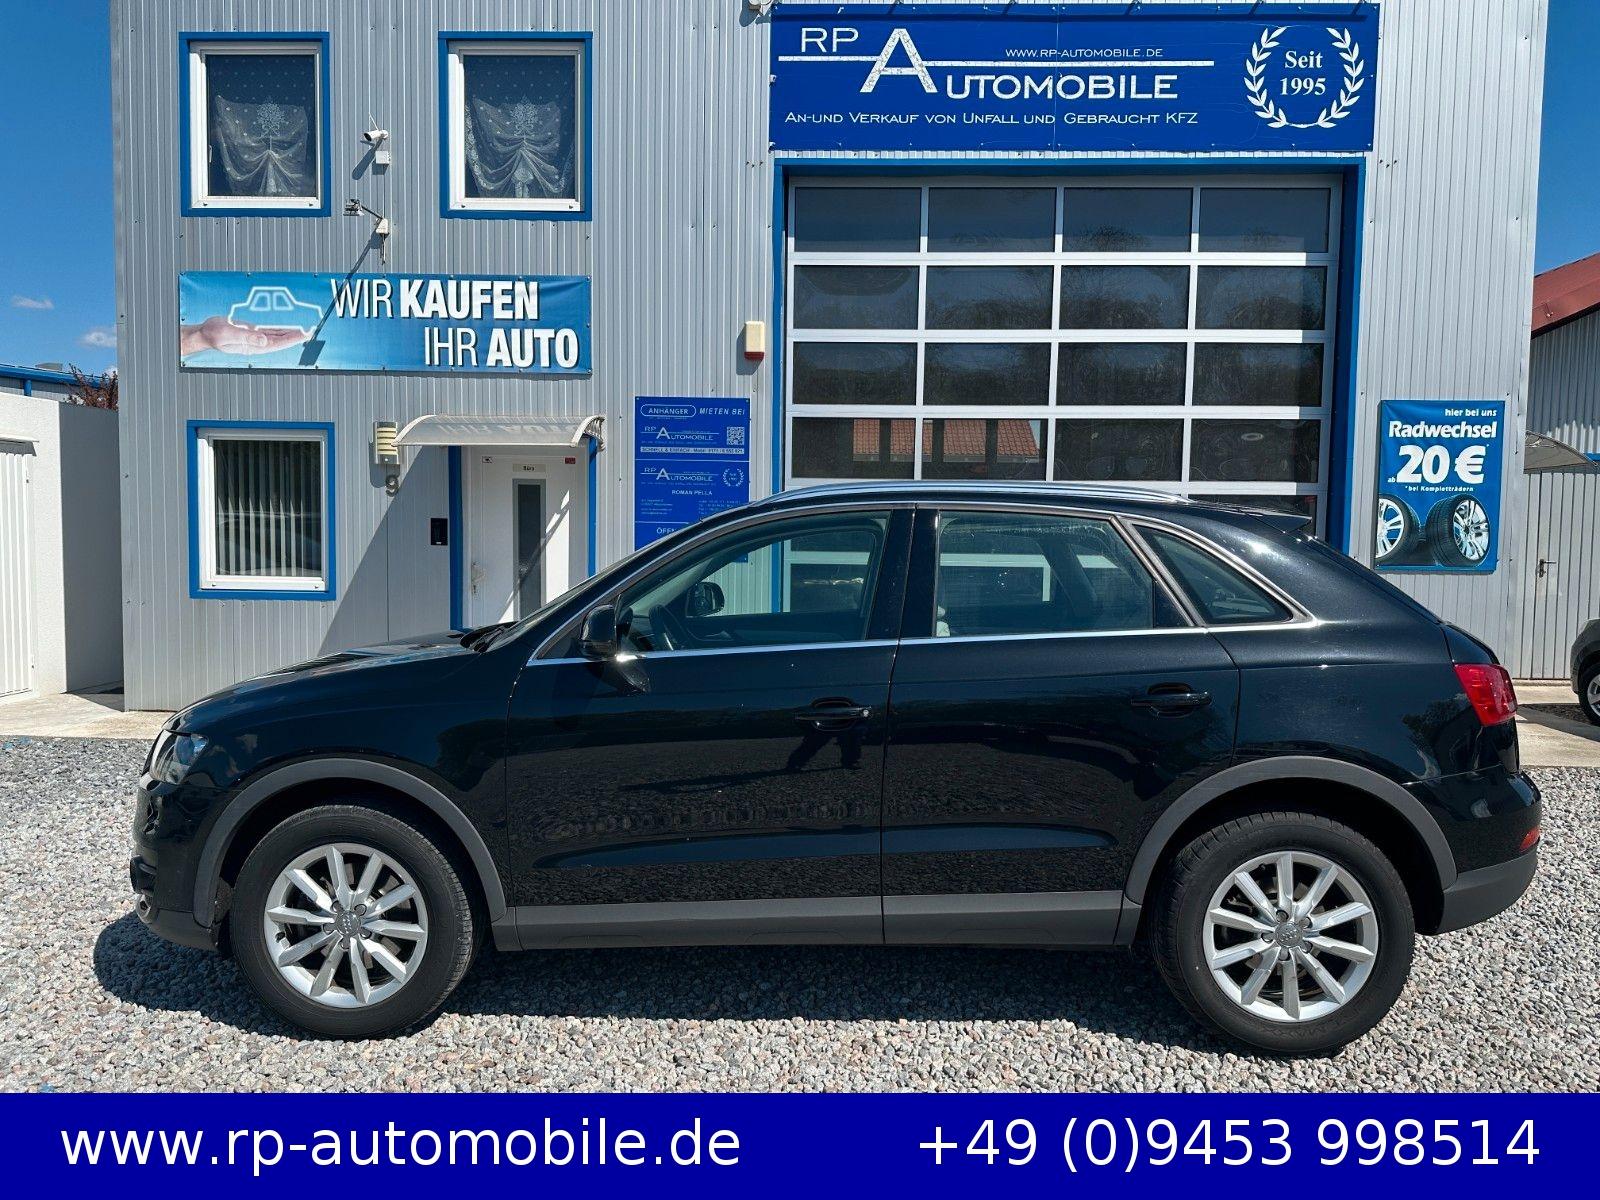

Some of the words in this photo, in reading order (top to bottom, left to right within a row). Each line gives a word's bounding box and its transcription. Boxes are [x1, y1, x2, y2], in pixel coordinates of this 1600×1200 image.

[802, 28, 859, 53] RP
[860, 27, 1178, 100] AUTOMOBILE
[1285, 50, 1323, 69] Seit
[1280, 77, 1326, 96] 1995
[849, 112, 920, 124] VERKAUF
[925, 114, 956, 124] VON
[963, 112, 1020, 124] UNFALL
[1024, 114, 1056, 125] UND
[1063, 112, 1161, 125] GEBRAUCHT
[1166, 112, 1199, 124] KFZ
[330, 278, 393, 319] WIR
[400, 279, 540, 320] KAUFEN
[424, 326, 478, 367] IHR
[485, 328, 579, 368] AUTO
[699, 407, 729, 415] MIETEN
[1444, 408, 1464, 417] hier
[1465, 409, 1479, 417] bei
[1388, 420, 1498, 438] Radwechsel
[1396, 444, 1451, 484] 20
